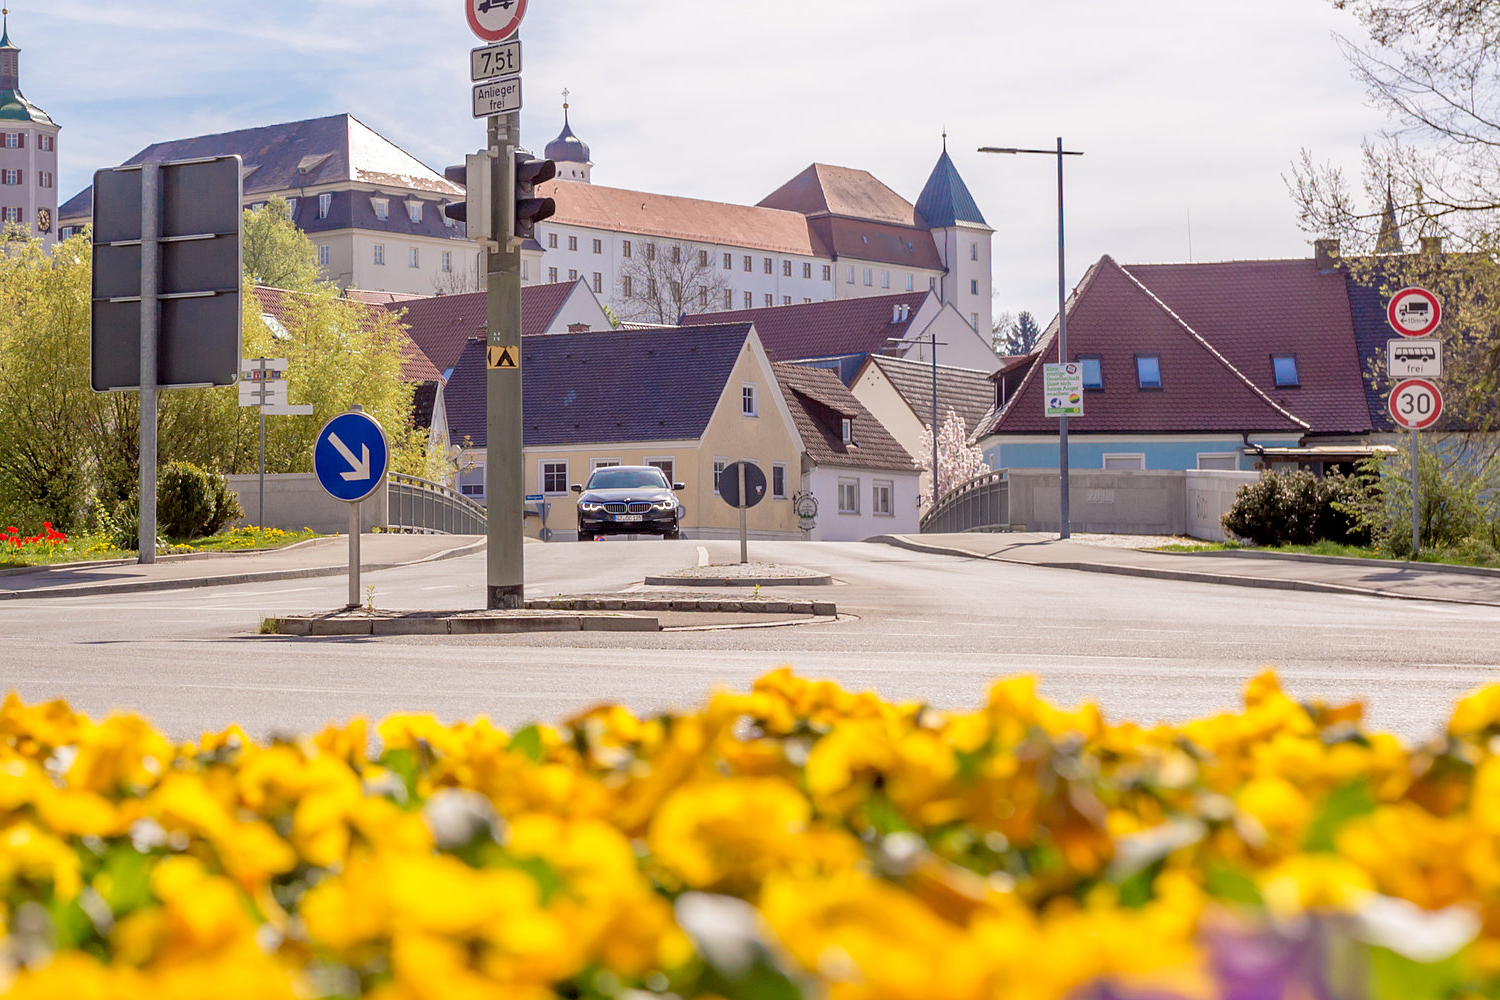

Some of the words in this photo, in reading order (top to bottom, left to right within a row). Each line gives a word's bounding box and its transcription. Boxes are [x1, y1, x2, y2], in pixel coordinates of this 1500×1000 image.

[478, 85, 516, 100] Anlieger
[489, 98, 505, 110] frei
[1407, 364, 1424, 373] frei
[1401, 393, 1430, 414] 30
